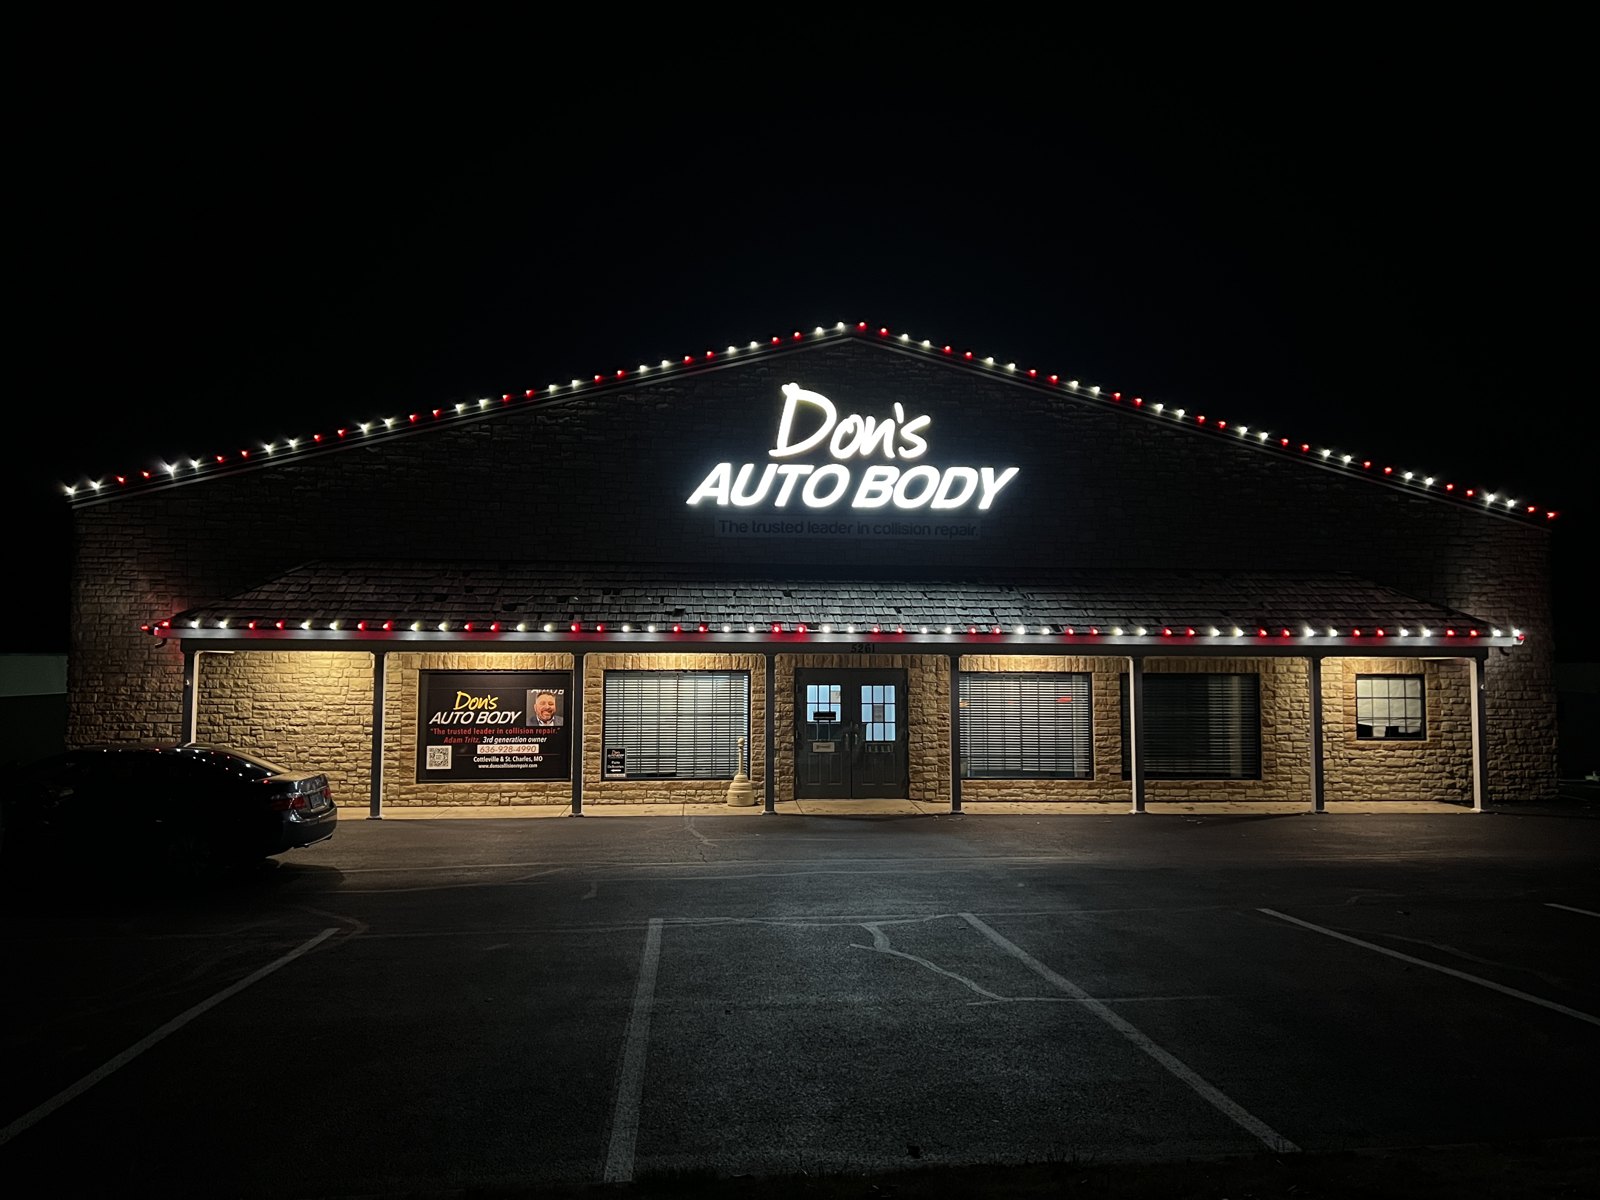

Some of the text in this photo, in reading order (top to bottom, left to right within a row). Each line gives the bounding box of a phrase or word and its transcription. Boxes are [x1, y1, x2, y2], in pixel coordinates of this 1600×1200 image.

[768, 381, 931, 460] Don's
[686, 462, 1020, 510] AUTO BODY
[719, 519, 979, 539] The trusted leader in collision repair.
[850, 643, 875, 654] 5261
[453, 690, 499, 711] Don's
[429, 711, 522, 724] AUTO BODY
[447, 727, 472, 735] trusted
[473, 727, 495, 735] leader
[496, 727, 504, 735] in
[505, 727, 534, 735] collision
[443, 736, 463, 744] Adam
[482, 736, 493, 744] 3rd
[493, 736, 527, 745] generation
[479, 745, 537, 754] 636-928-4990
